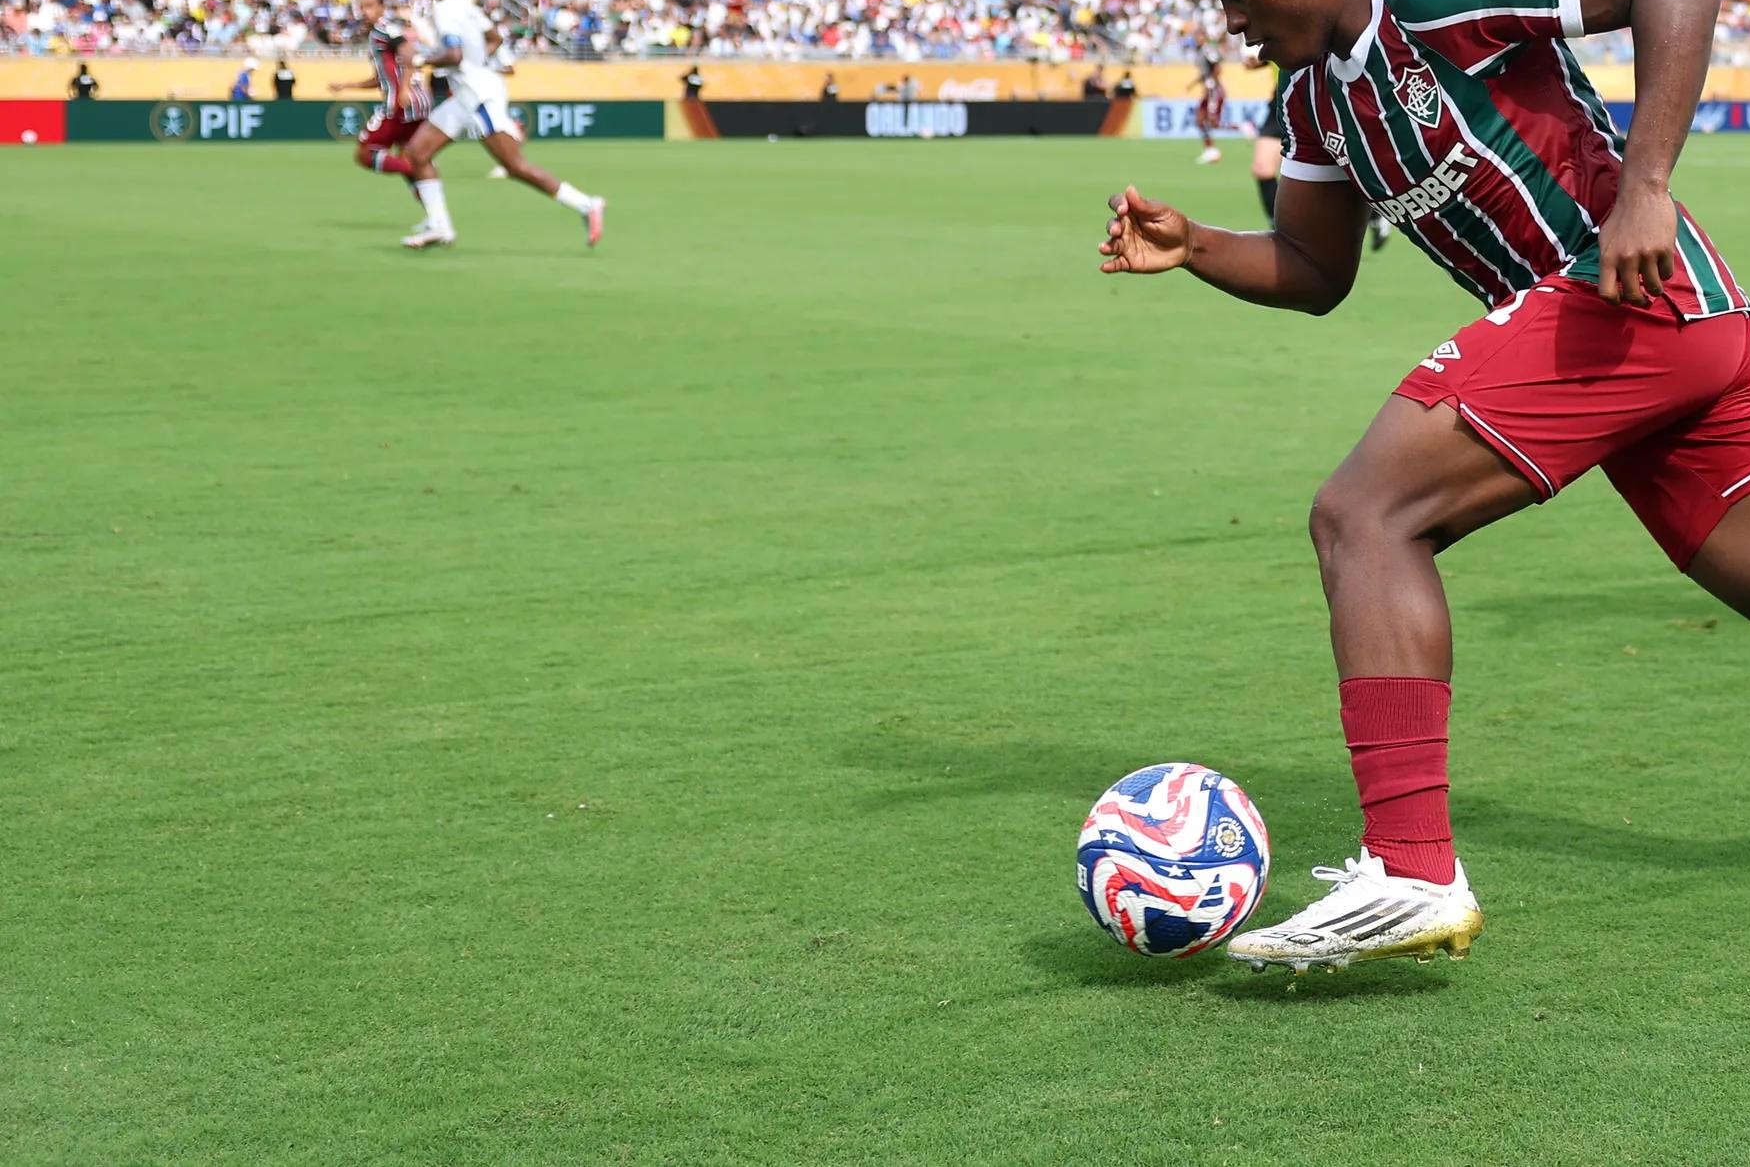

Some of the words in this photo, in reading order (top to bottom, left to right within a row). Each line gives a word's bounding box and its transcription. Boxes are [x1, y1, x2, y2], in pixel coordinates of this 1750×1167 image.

[200, 104, 265, 138] PIF
[538, 104, 597, 136] PIF
[1371, 141, 1479, 225] UPERBET
